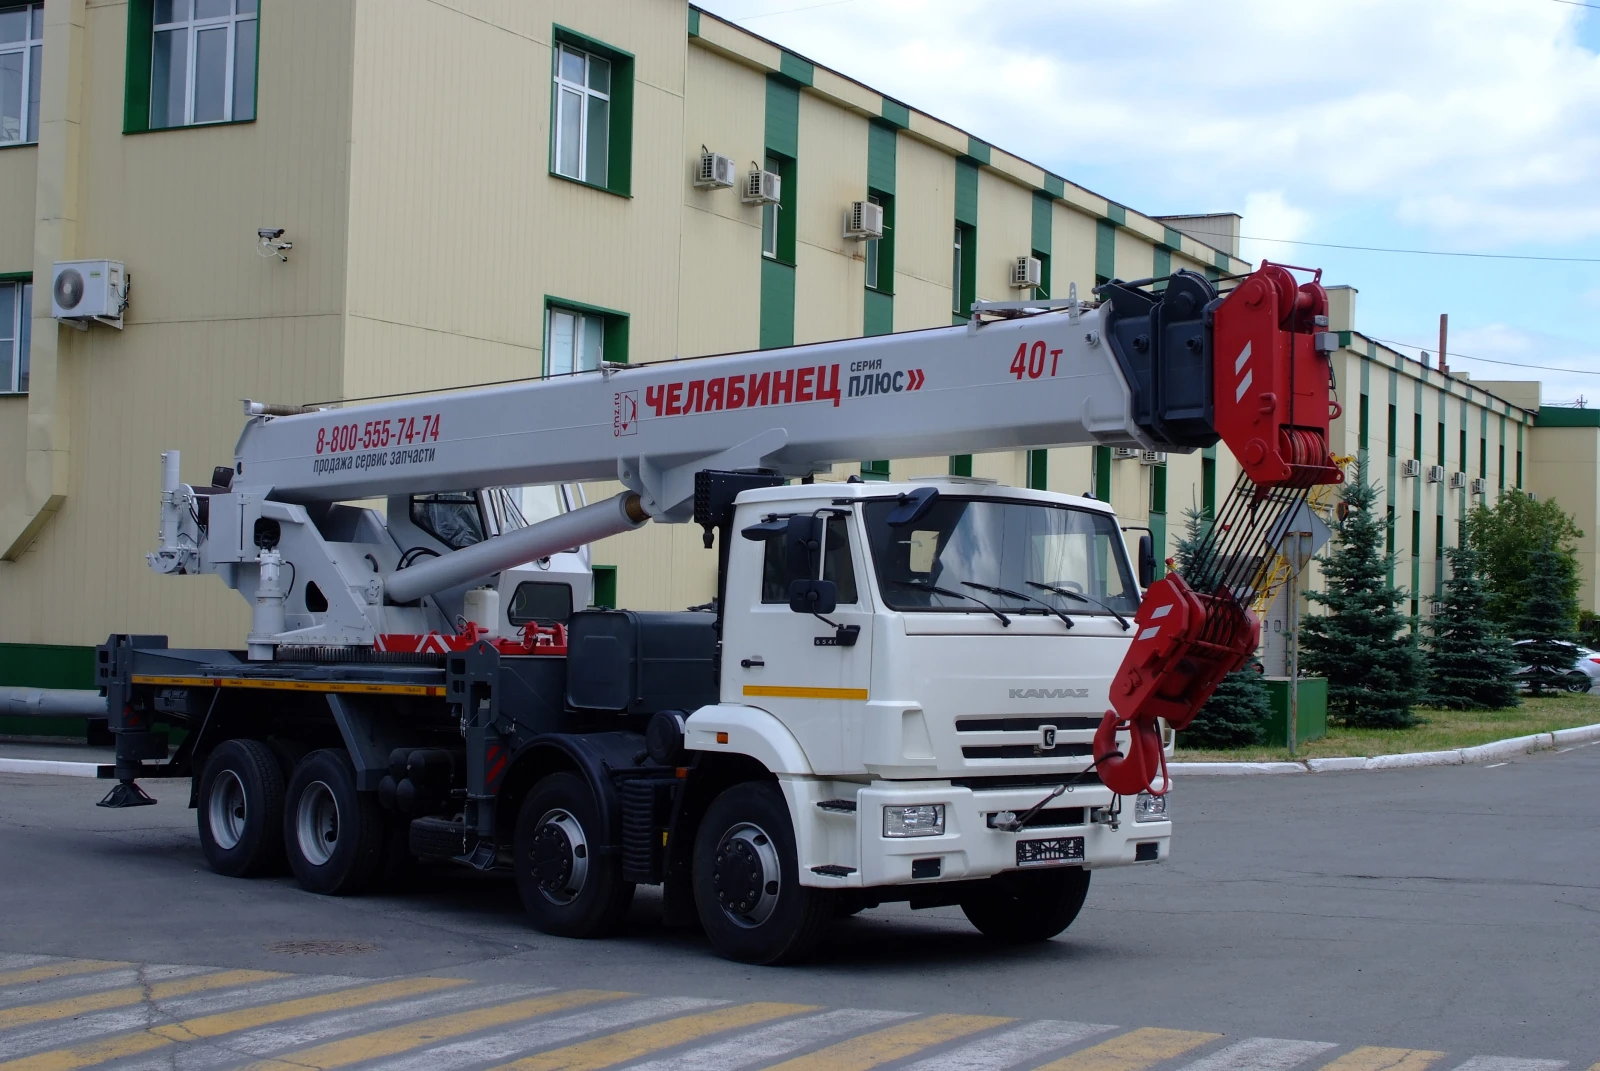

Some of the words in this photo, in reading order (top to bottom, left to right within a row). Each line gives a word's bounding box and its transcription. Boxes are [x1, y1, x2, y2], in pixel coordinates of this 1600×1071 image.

[850, 359, 882, 372] СЕРИЯ
[645, 363, 841, 408] ЧЕЛЯБИНЕЦ
[848, 370, 904, 397] ПЛЮС
[316, 413, 441, 454] 8-800-555-74-74
[313, 456, 353, 475] продажа
[355, 451, 388, 471] сервис
[390, 447, 436, 464] запчасти
[1008, 688, 1089, 699] KAMAZ
